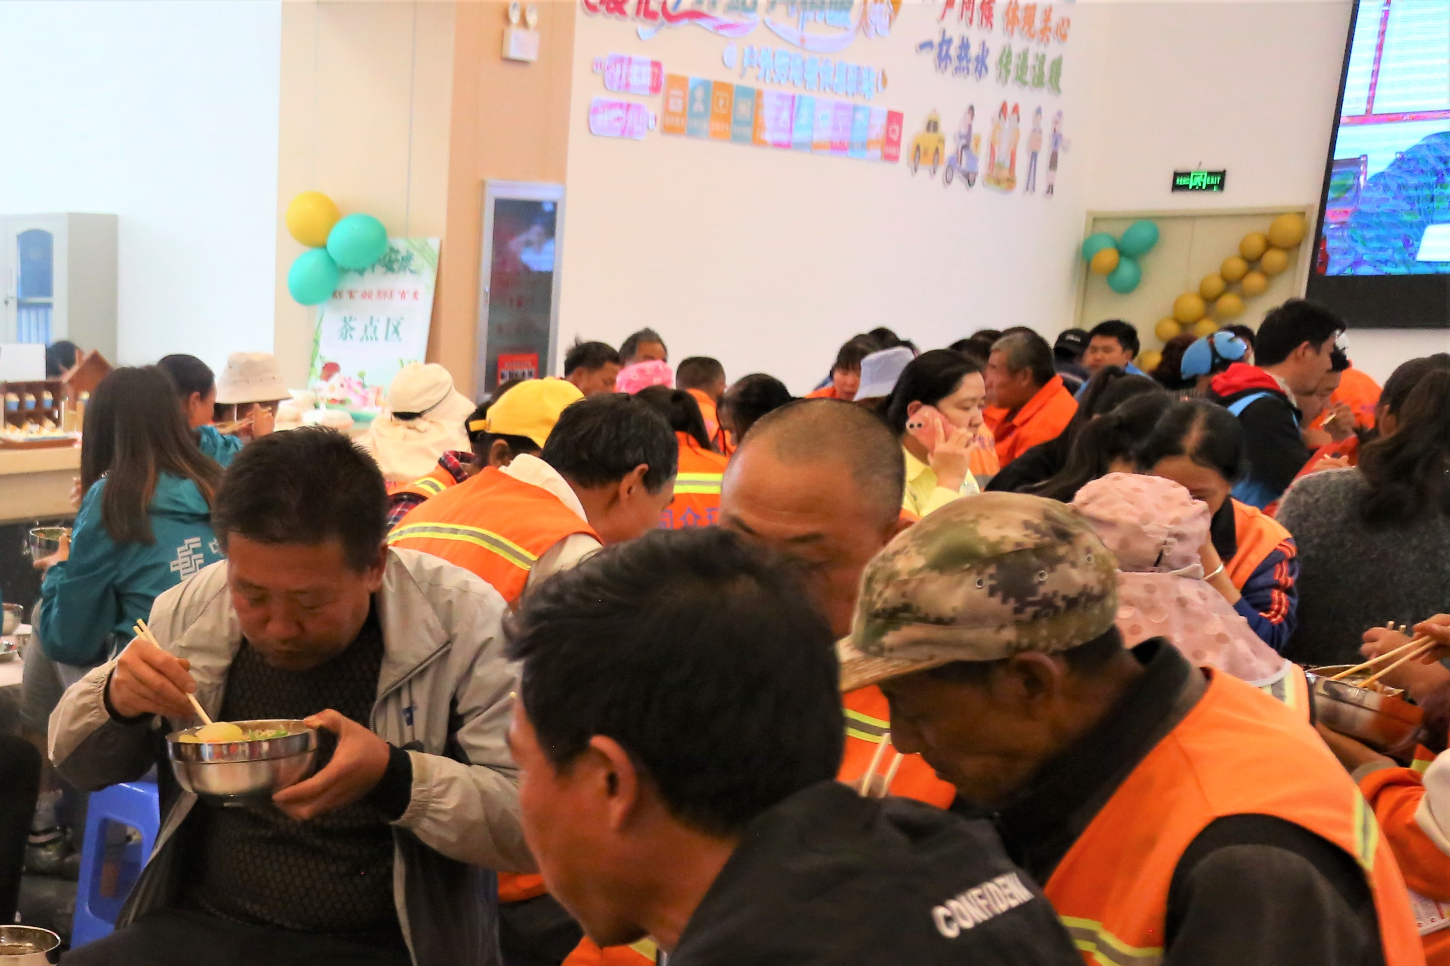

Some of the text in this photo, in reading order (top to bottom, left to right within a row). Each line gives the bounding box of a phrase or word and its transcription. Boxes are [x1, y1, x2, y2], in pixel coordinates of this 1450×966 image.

[919, 28, 990, 79] 一杯热水
[339, 314, 404, 342] 茶点区
